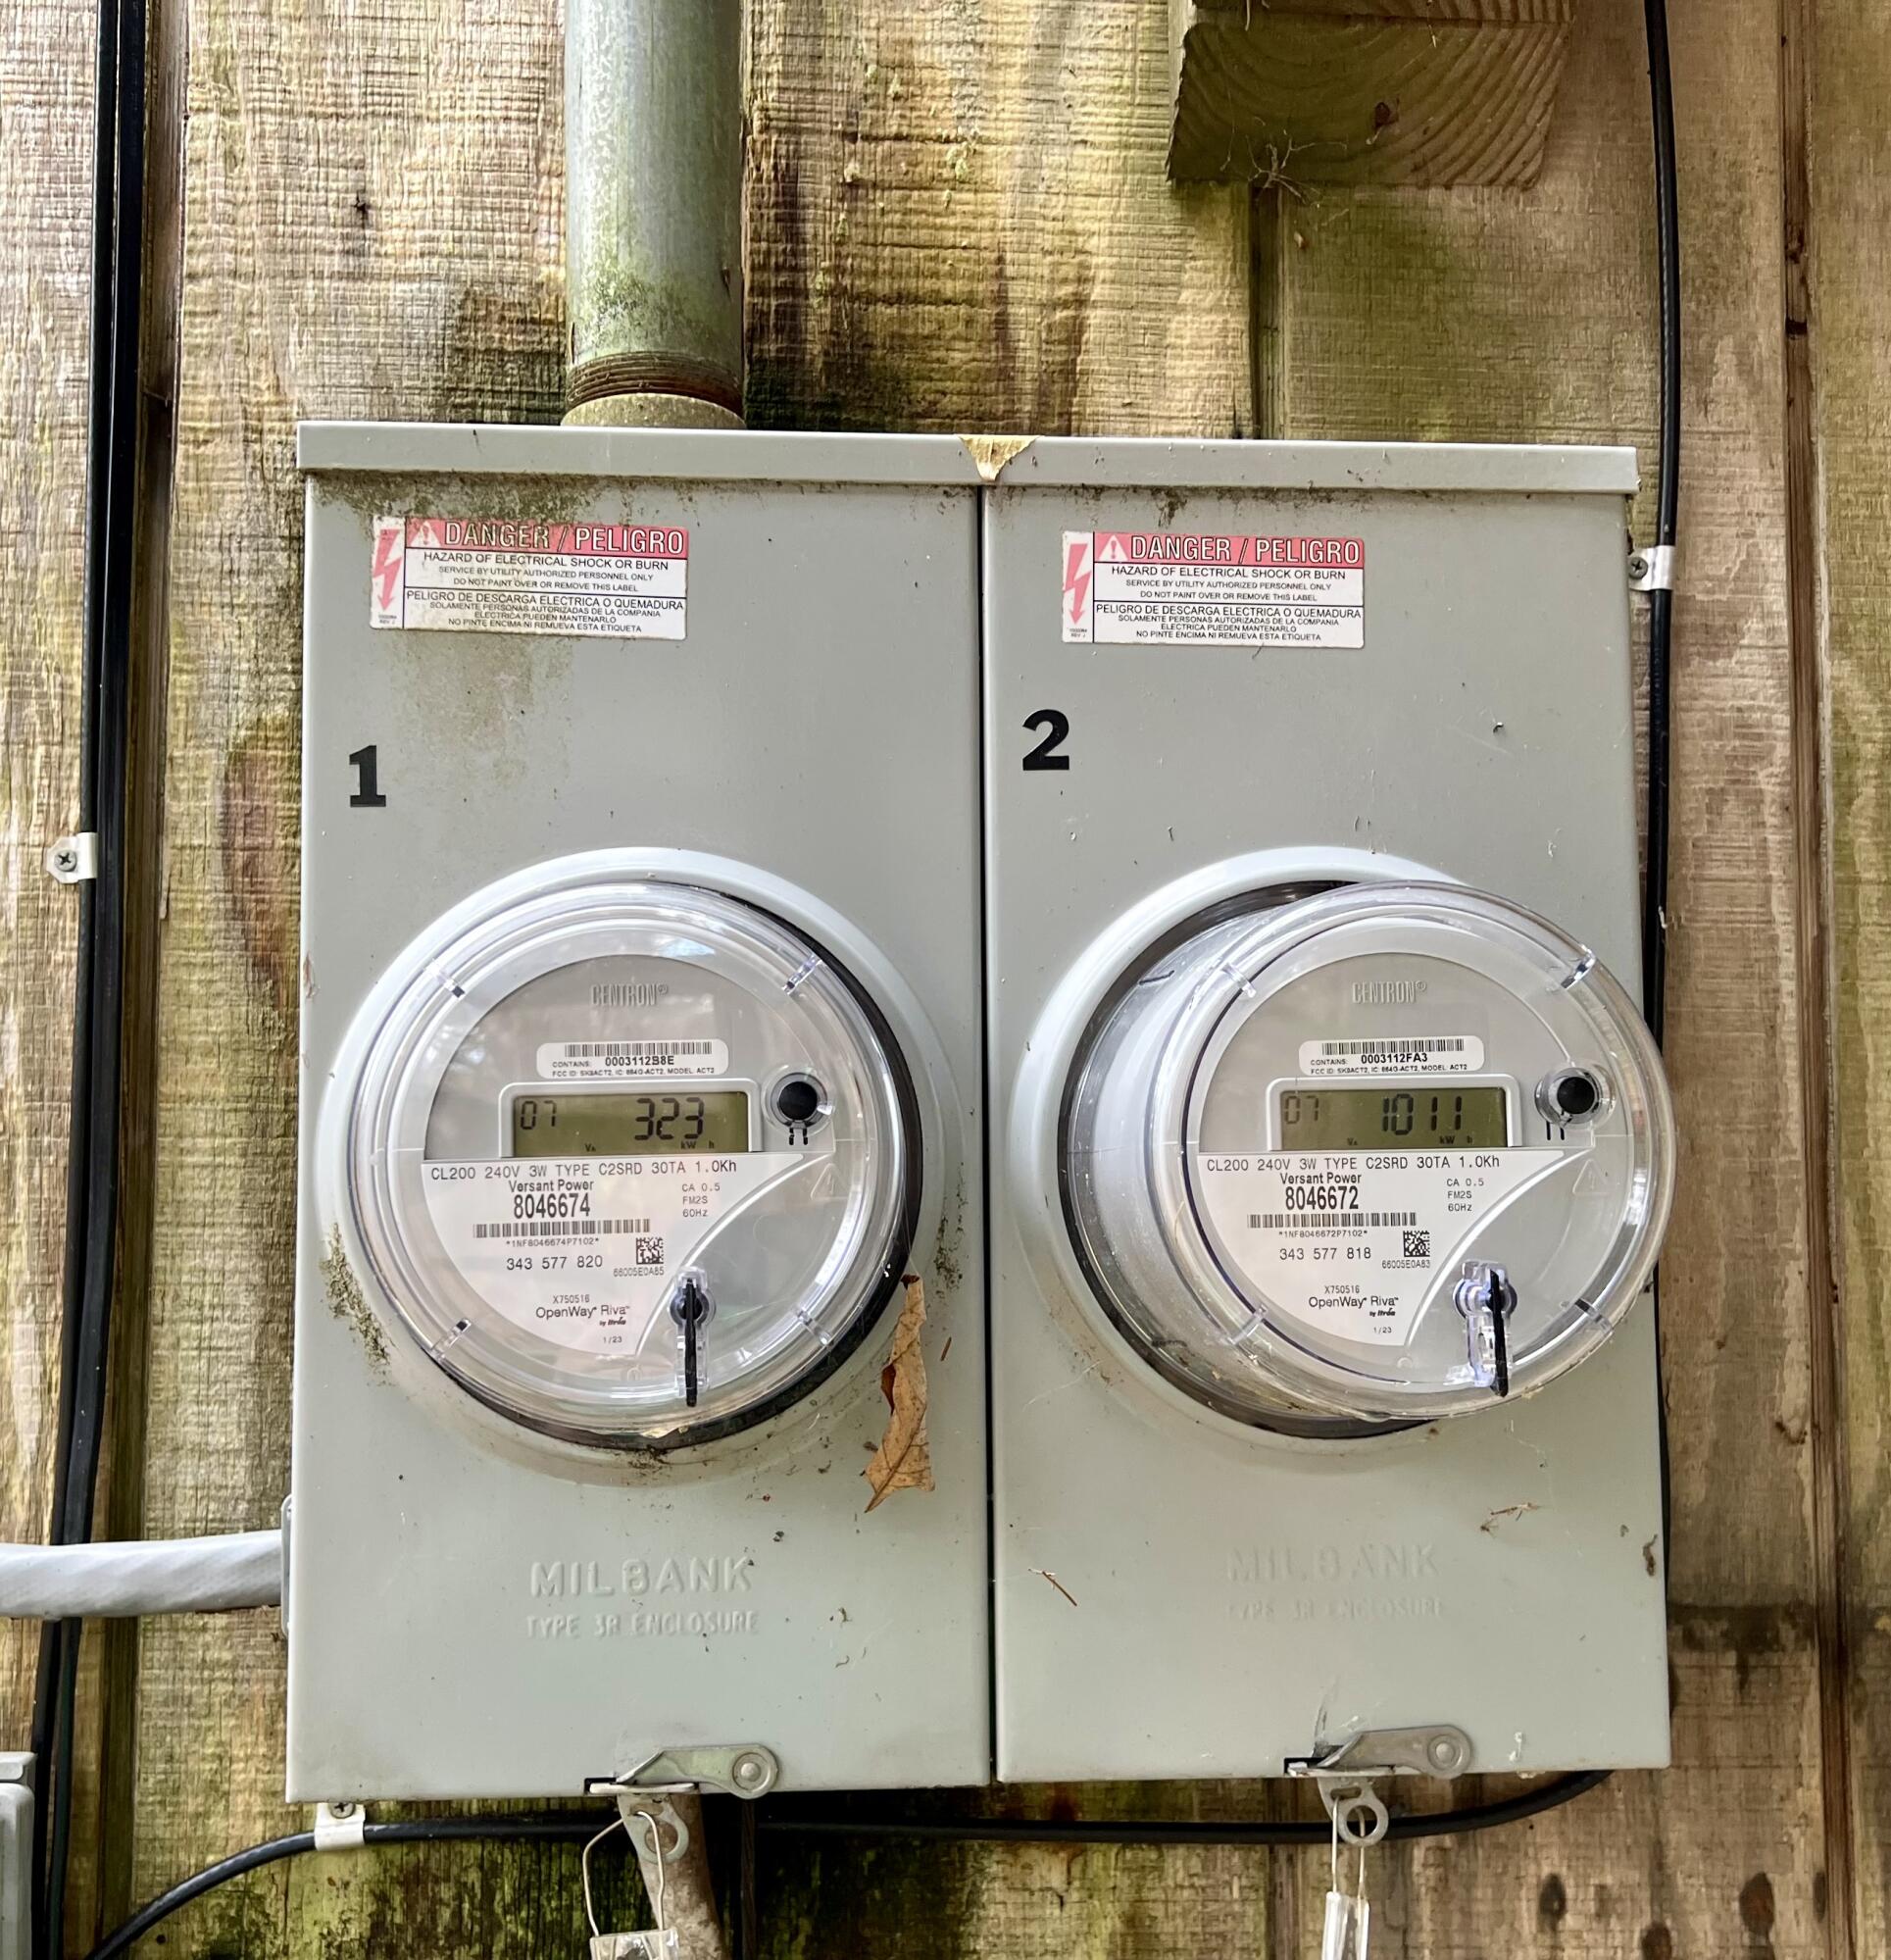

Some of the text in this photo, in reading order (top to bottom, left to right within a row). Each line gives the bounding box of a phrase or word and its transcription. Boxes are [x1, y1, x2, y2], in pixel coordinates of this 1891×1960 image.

[444, 522, 550, 548] DANGER
[574, 527, 684, 554] PELIGRO
[1130, 534, 1231, 561] DANGER
[1256, 537, 1361, 564] PELIGRO
[423, 552, 669, 571] HAZARD OF ELECTRICAL SHOCK OR BURN
[523, 568, 576, 578] AUTHORIZED
[578, 572, 628, 580] PERSONNEL
[1112, 566, 1346, 579] HAZARD OF ELECTRICAL SHOCK OR BURN
[514, 579, 537, 588] OVER
[554, 581, 590, 590] REMOVE
[592, 582, 611, 591] THIS
[613, 583, 638, 592] LABEL
[1125, 578, 1161, 587] SERVICE
[1175, 579, 1205, 588] UTILITY
[1206, 580, 1258, 589] AUTHORIZED
[1259, 581, 1308, 590] PERSONNEL
[1310, 582, 1332, 591] ONLY
[406, 590, 683, 610] PELIGRO DE DESCARGA ELECTRICA O QUEMADURA
[1292, 593, 1318, 602] LABEL
[429, 601, 481, 611] SOLAMENTE
[482, 603, 529, 613] PERSONAS
[531, 605, 588, 615] AUTORIZADAS
[591, 607, 603, 616] DE
[1096, 603, 1362, 619] PELIGRO DE DESCARGA ELECTRICA O QUEMADURA
[448, 618, 461, 627] NO
[463, 619, 487, 628] PINTE
[489, 619, 522, 628] ENCIMA
[534, 621, 575, 630] REMUEVA
[601, 624, 642, 632] ETIQUETA
[473, 611, 617, 624] ELECTRICA PUEDEN MANTENARLO
[1118, 614, 1167, 623] SOLAMENTE
[1169, 615, 1213, 624] PERSONAS
[1215, 616, 1270, 625] AUTORIZADAS
[1218, 631, 1257, 640] REMUEVA
[1281, 632, 1321, 641] ETIQUETA
[1242, 625, 1297, 633] MANTENARLO
[1022, 709, 1070, 771] 2
[349, 745, 386, 807] 1
[1361, 1053, 1428, 1064] 0003112FA3
[520, 1097, 704, 1140] 07 323
[1284, 1093, 1463, 1135] 07 1011
[431, 1159, 737, 1180] CL200 240V 3W TYPE C2SRD 30TA 1.0Kh
[1207, 1155, 1500, 1171] CL200 240V 3W TYPE C2SRD 30TA 1.0Kh
[509, 1179, 594, 1192] Versant Power
[1280, 1172, 1362, 1184] Versant Power
[1446, 1178, 1484, 1186] CA 0.5
[681, 1182, 721, 1192] CA 0.5
[1285, 1185, 1359, 1210] 8046672
[514, 1192, 590, 1219] 8046674
[682, 1208, 708, 1217] 60Hz
[1448, 1203, 1472, 1212] 60Hz
[1279, 1246, 1371, 1261] 343 577 818
[506, 1255, 603, 1271] 343 577 820
[530, 1555, 753, 1597] MILBANK
[526, 1614, 579, 1638] TYPE
